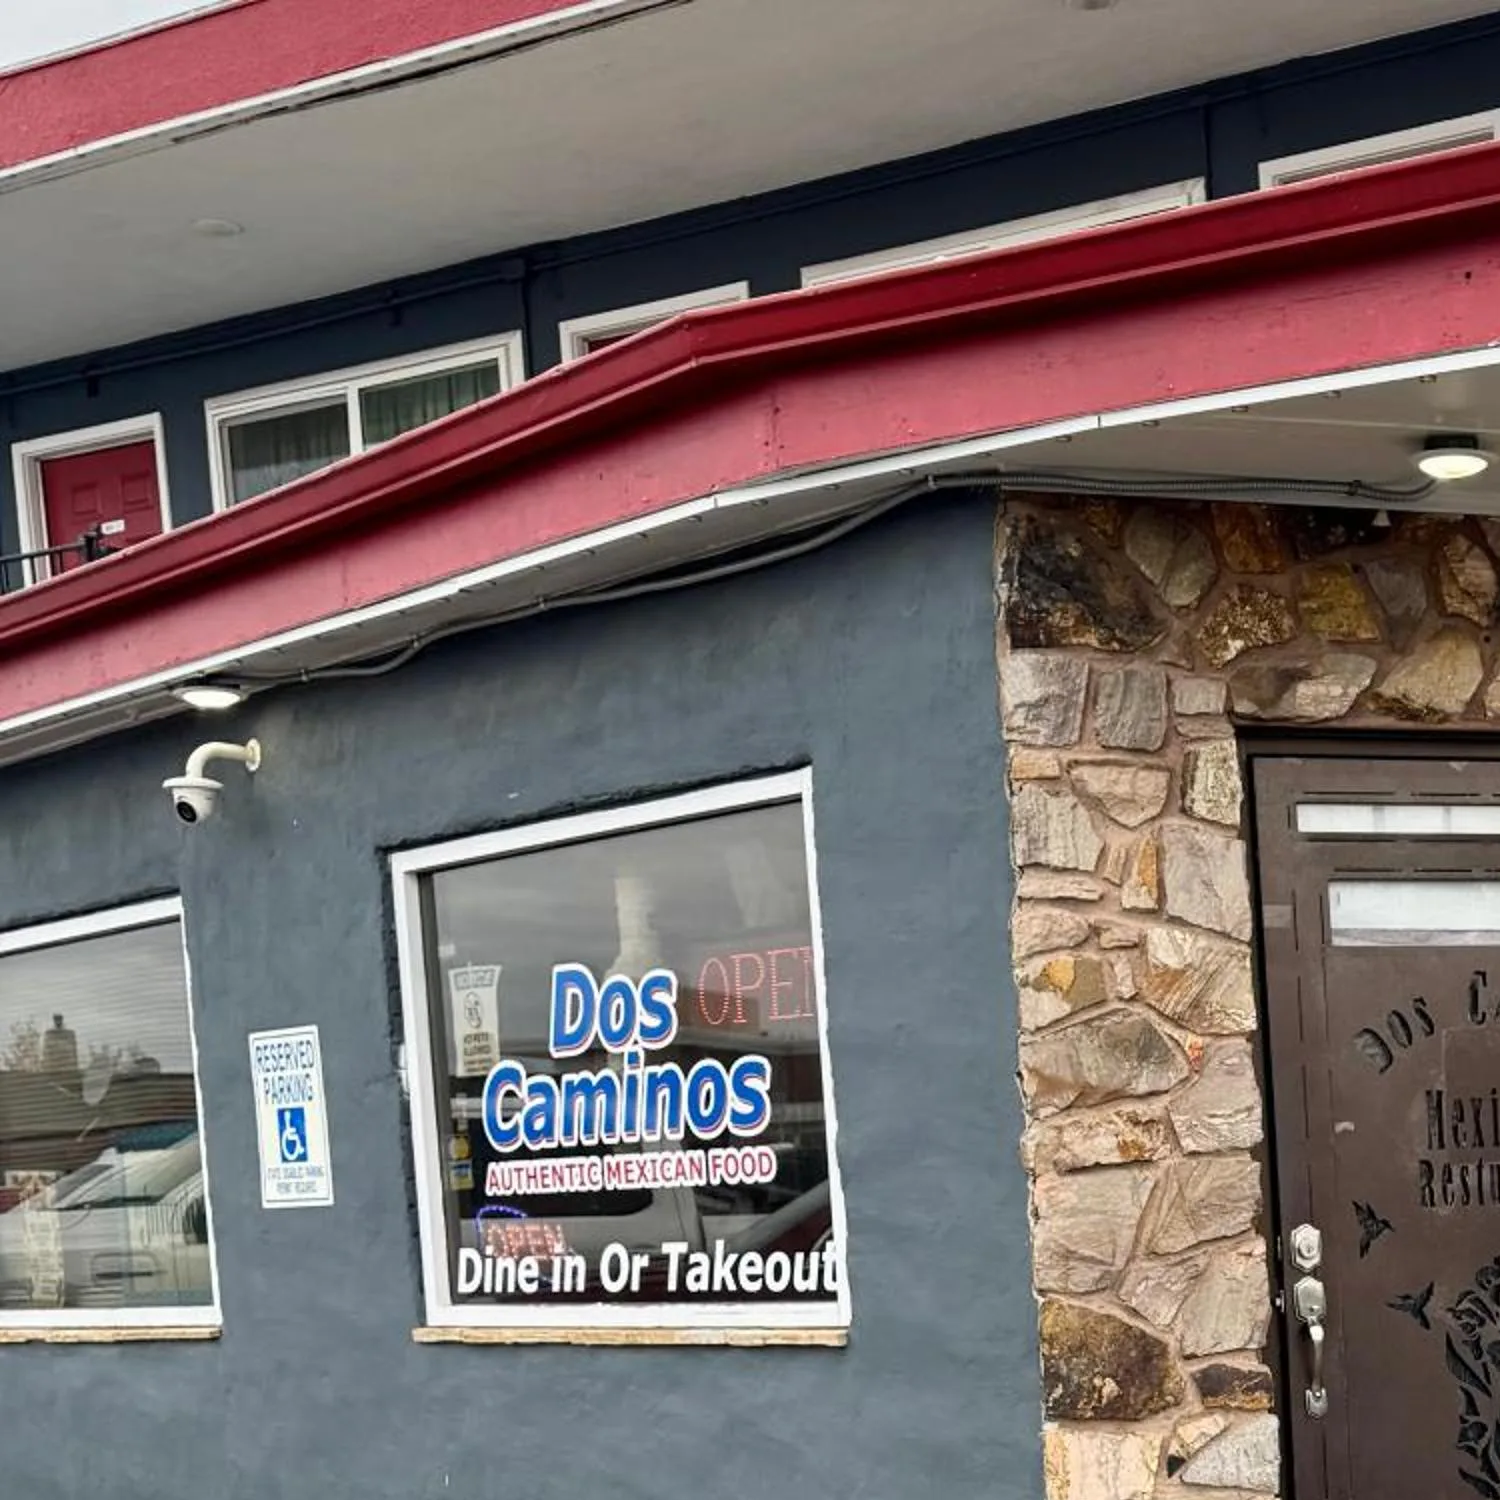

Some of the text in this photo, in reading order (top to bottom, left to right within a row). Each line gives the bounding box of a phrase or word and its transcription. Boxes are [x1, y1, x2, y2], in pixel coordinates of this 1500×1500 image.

[549, 962, 678, 1057] Dos
[1355, 997, 1435, 1074] Dos
[255, 1040, 315, 1073] RESERVED
[264, 1072, 314, 1104] PARKING
[483, 1050, 771, 1152] Caminos
[485, 1159, 602, 1196] AUTHENTIC
[604, 1151, 706, 1189] MEXICAN
[709, 1146, 777, 1184] FOOD
[458, 1247, 540, 1293] Dine
[599, 1242, 650, 1292] Or
[661, 1238, 839, 1292] Takeout
